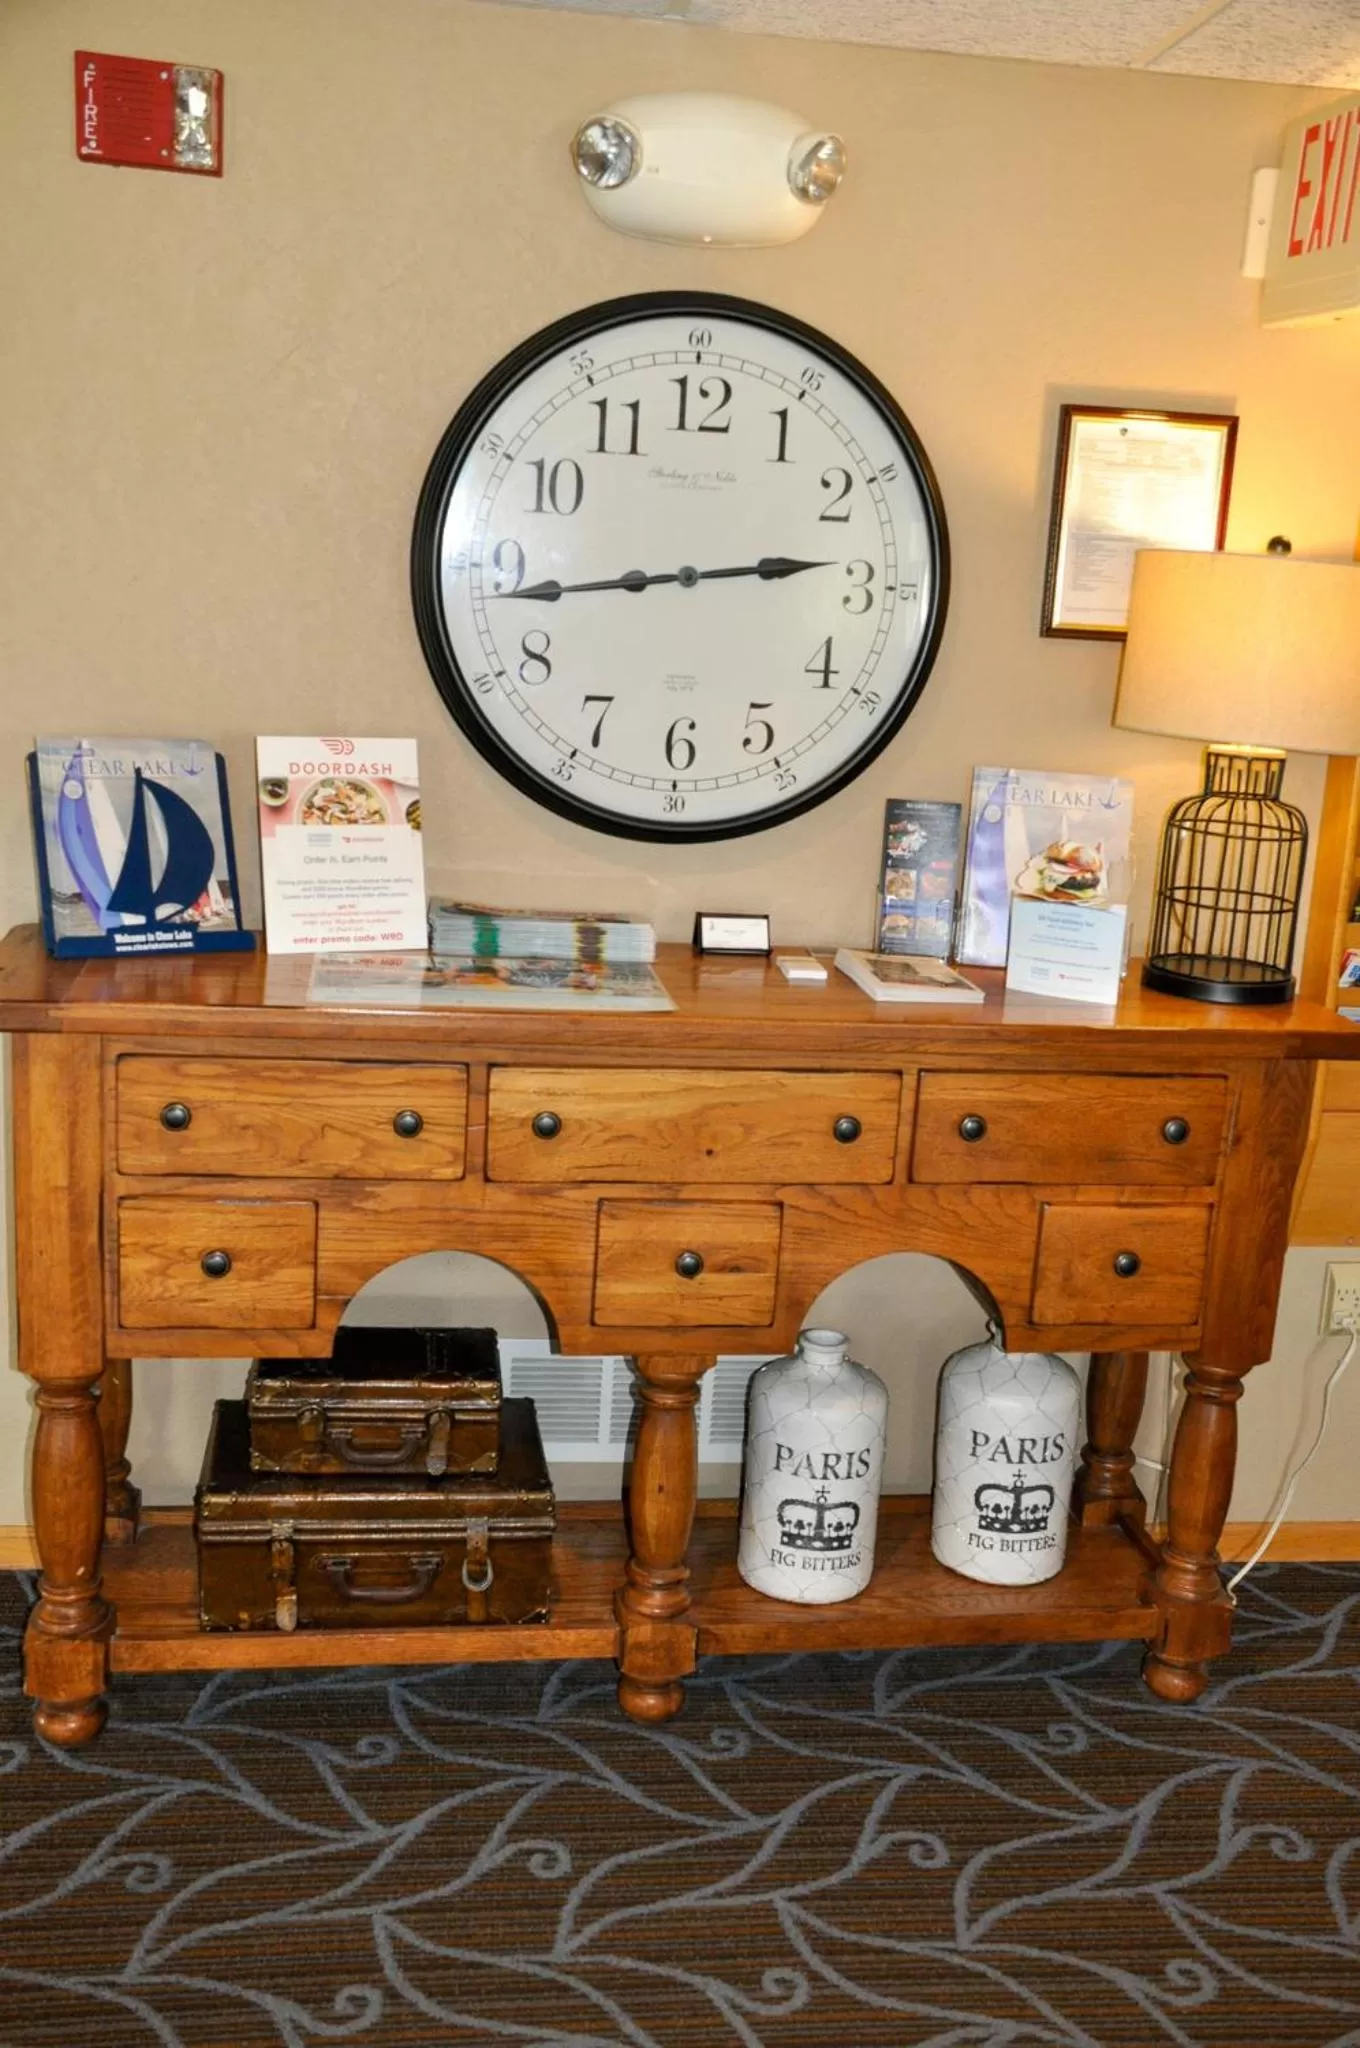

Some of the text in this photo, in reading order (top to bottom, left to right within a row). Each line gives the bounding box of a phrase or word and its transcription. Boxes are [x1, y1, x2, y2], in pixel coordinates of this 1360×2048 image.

[84, 70, 98, 140] FIRE
[688, 328, 712, 348] 60
[569, 350, 595, 376] 55
[800, 366, 825, 392] 05
[665, 374, 732, 433] 12
[586, 397, 649, 456] 11
[765, 407, 796, 464] 1
[480, 432, 505, 459] 50
[524, 457, 584, 516] 10
[878, 462, 898, 482] 10
[818, 466, 853, 523] 2
[493, 539, 525, 596] 9
[842, 559, 875, 615] 3
[900, 582, 918, 601] 15
[519, 629, 551, 686] 8
[804, 636, 840, 690] 4
[471, 671, 495, 694] 40
[859, 690, 882, 716] 20
[580, 695, 615, 748] 7
[742, 702, 774, 754] 5
[665, 717, 696, 771] 6
[288, 762, 392, 775] DOORDASH
[551, 757, 577, 782] 35
[774, 767, 797, 791] 25
[662, 795, 685, 813] 30
[773, 1443, 872, 1481] PARIS
[969, 1430, 1066, 1465] PARIS
[769, 1549, 862, 1572] FIG BITTERS
[967, 1533, 1058, 1553] FIG BITTERS
